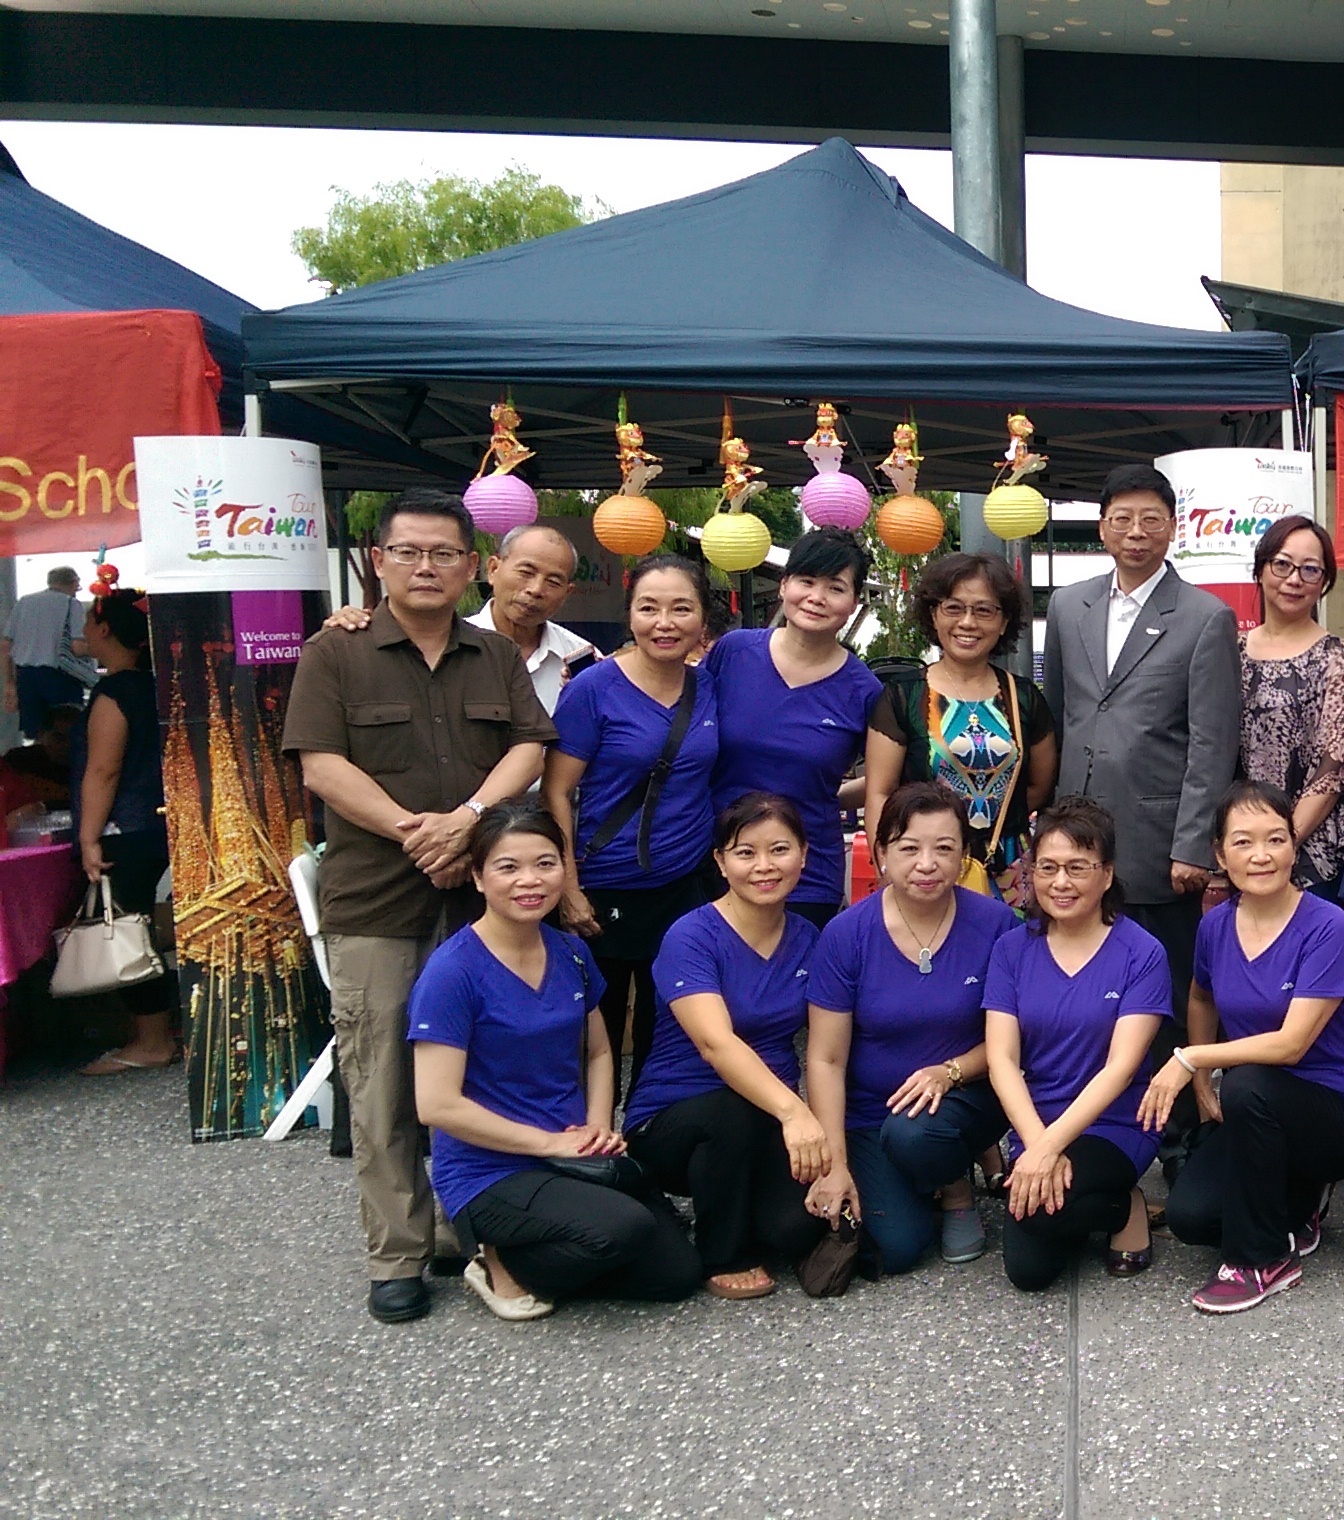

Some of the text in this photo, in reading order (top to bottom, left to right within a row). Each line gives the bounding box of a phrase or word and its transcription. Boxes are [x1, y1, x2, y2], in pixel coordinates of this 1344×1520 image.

[287, 493, 316, 514] Tour
[1248, 495, 1293, 515] Tour
[214, 503, 318, 538] Taiwan
[1189, 507, 1272, 538] Taiwa
[240, 631, 301, 642] Welcome to
[242, 643, 302, 659] Taiwan
